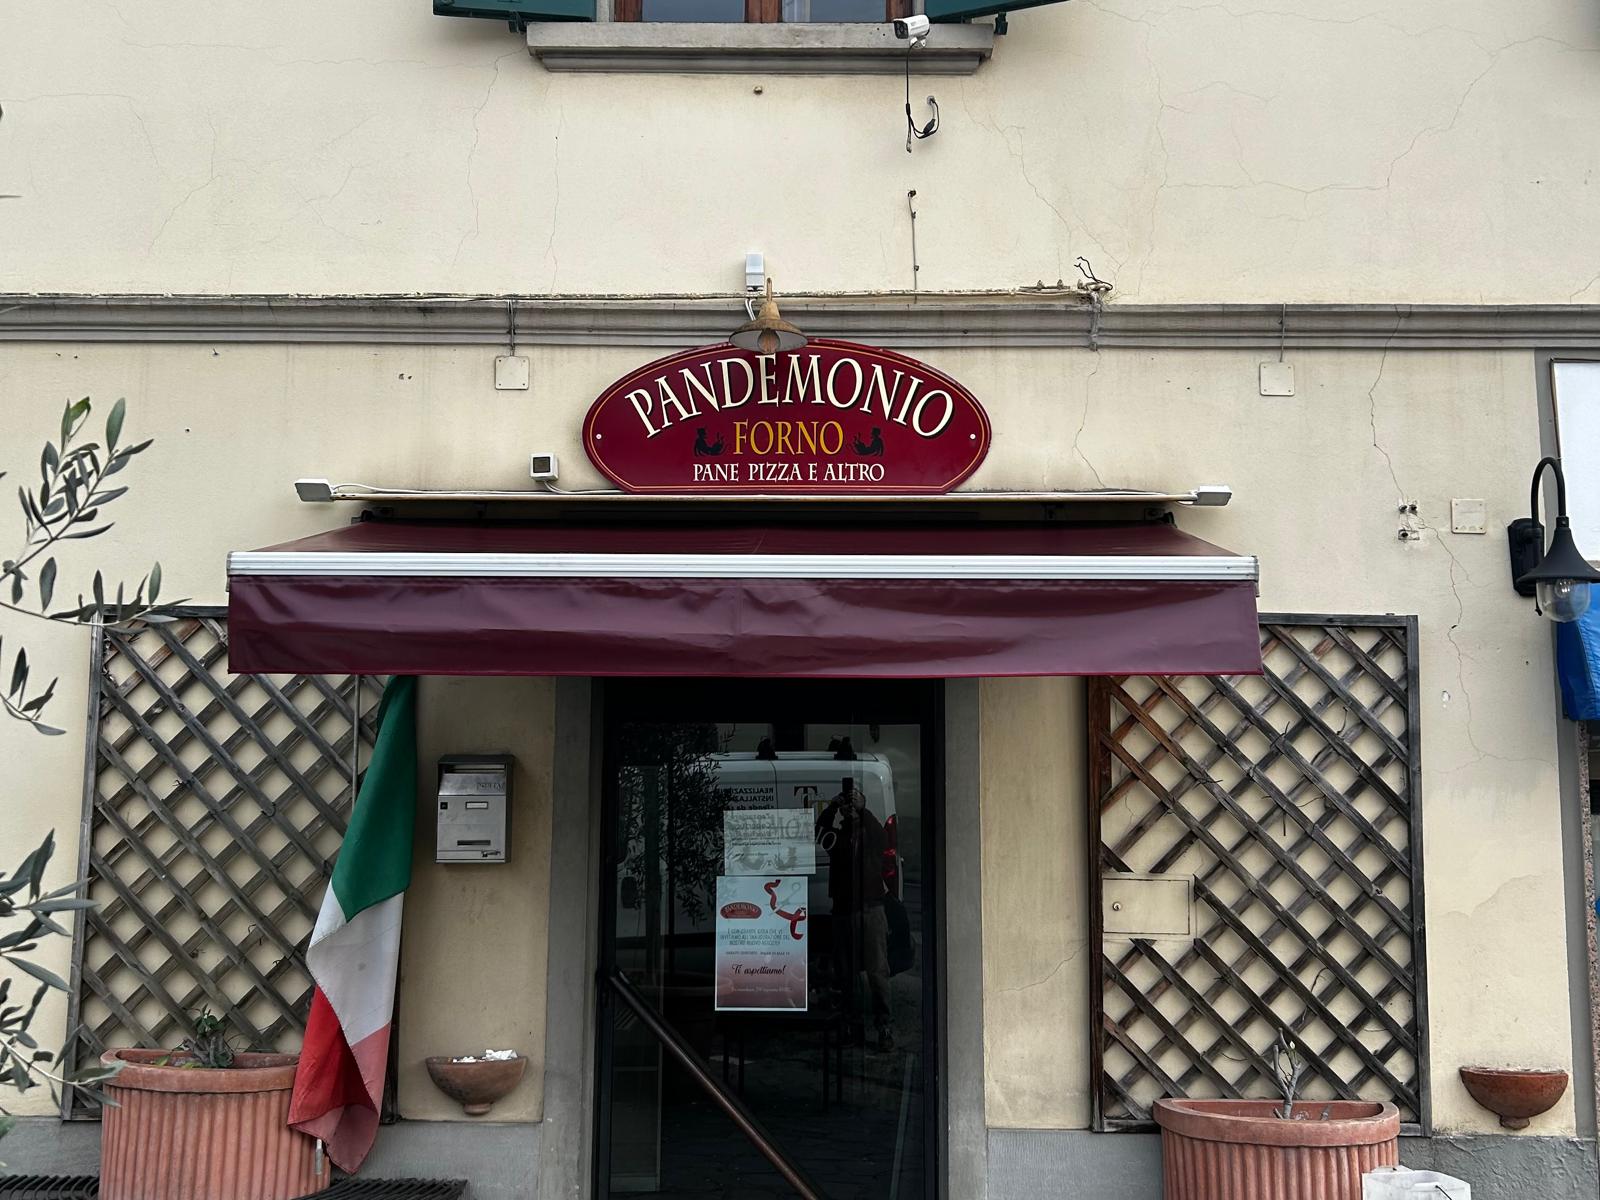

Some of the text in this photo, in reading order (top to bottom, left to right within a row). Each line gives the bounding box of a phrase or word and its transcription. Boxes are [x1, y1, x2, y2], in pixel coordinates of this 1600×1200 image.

[624, 353, 954, 439] PANDEMONIO
[733, 420, 844, 456] FORNO
[692, 463, 885, 483] PANE PIZZA E ALTRO
[731, 964, 785, 976] Ti aspettiamo!
